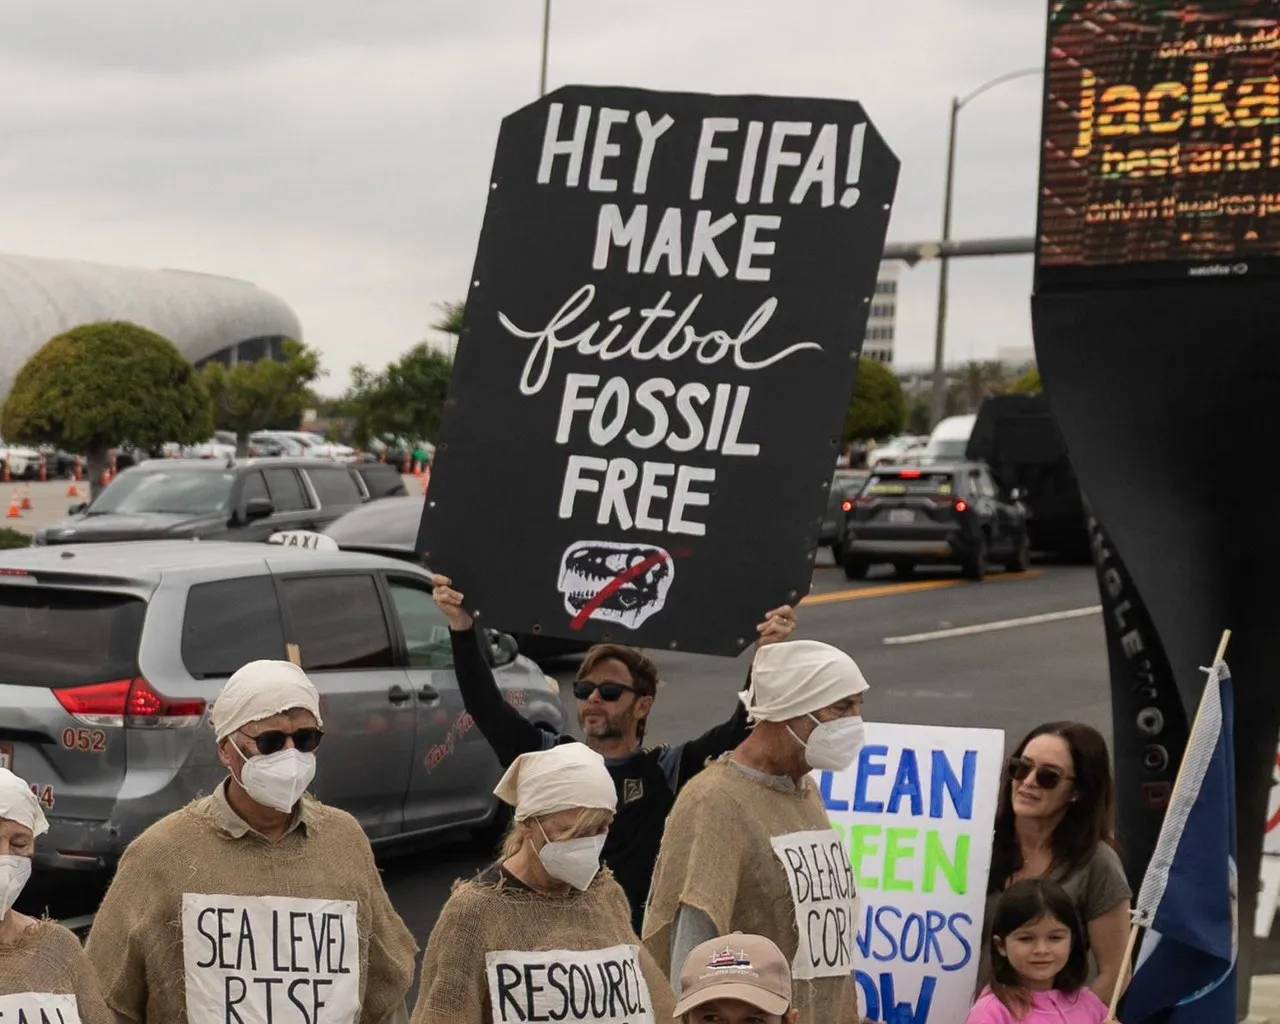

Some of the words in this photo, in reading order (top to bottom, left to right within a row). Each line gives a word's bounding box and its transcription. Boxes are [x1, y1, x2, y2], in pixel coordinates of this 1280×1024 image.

[536, 102, 675, 194] HEY
[689, 117, 867, 209] FIFA!
[592, 203, 782, 282] MAKE
[497, 284, 824, 395] fútbol
[555, 372, 760, 457] FOSSIL
[558, 454, 716, 536] FREE
[282, 533, 319, 550] TAXI
[61, 727, 106, 751] 052
[820, 745, 978, 820] LEAN
[832, 823, 971, 895] EEN
[196, 907, 257, 971] SEA
[272, 909, 351, 974] LEVEL
[808, 906, 852, 968] COR
